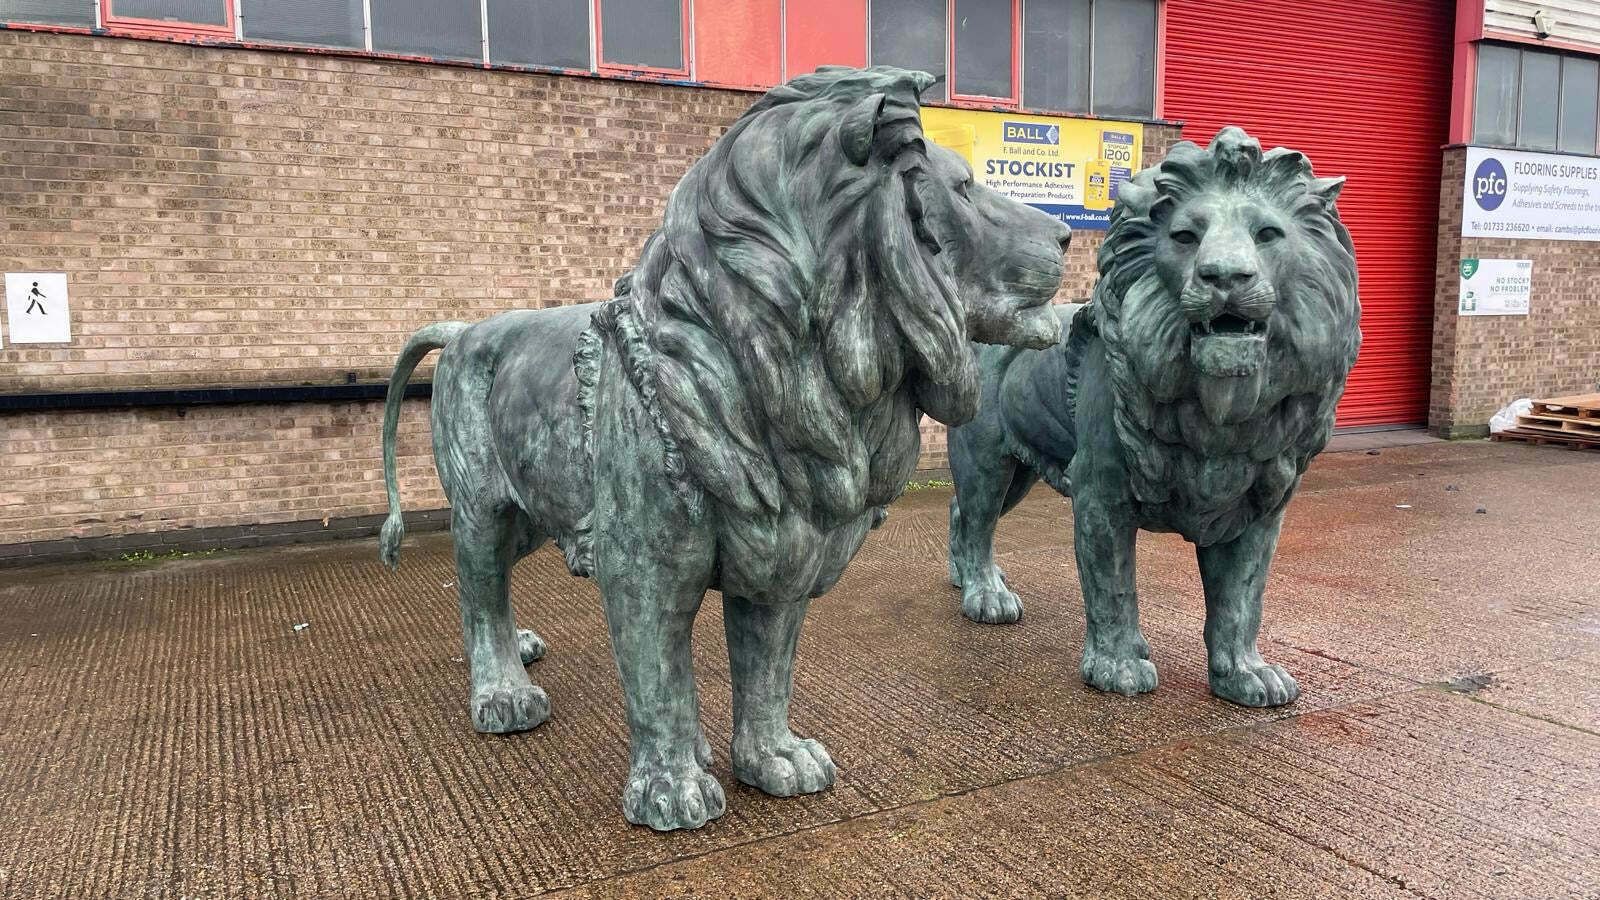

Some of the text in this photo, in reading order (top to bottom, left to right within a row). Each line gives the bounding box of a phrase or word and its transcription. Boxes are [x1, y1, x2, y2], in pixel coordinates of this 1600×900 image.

[1007, 126, 1043, 139] BALL
[1009, 147, 1022, 156] Ball
[1104, 149, 1130, 161] 1200
[986, 159, 1076, 179] STOCKIST
[1514, 161, 1598, 180] FLOORING SUPPLIES
[986, 180, 1074, 190] High Performance Adhesives
[1476, 172, 1505, 199] pfc
[1512, 182, 1543, 197] Supplying
[1543, 184, 1563, 197] Safety
[1010, 190, 1046, 199] Preparation
[1047, 192, 1074, 200] Products
[1512, 199, 1542, 209] Adhesives
[1542, 200, 1554, 210] and
[1554, 200, 1577, 211] Screeds
[1577, 202, 1584, 212] to
[1584, 202, 1595, 212] the
[1471, 221, 1482, 231] Tel:
[1483, 222, 1504, 231] 01733
[1536, 224, 1554, 233] email:
